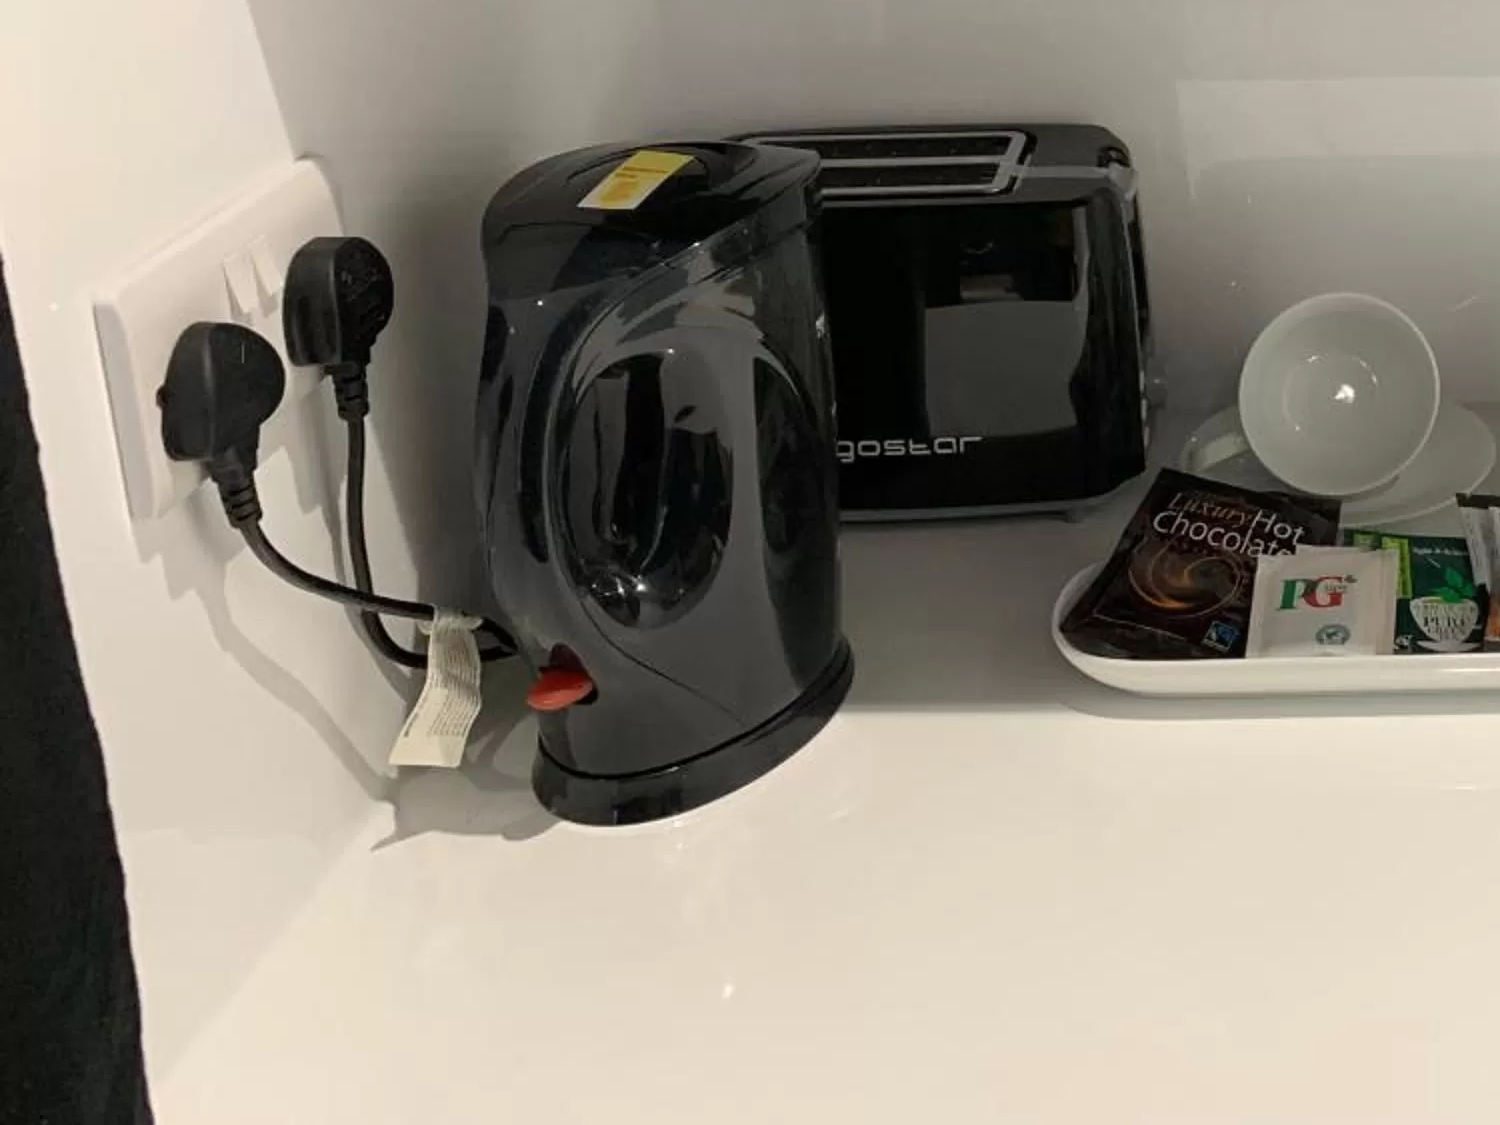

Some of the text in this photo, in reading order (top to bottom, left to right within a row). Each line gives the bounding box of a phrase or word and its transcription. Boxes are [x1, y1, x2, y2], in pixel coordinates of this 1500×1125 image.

[1167, 491, 1306, 546] Luxury Hot
[1276, 576, 1344, 612] PG
